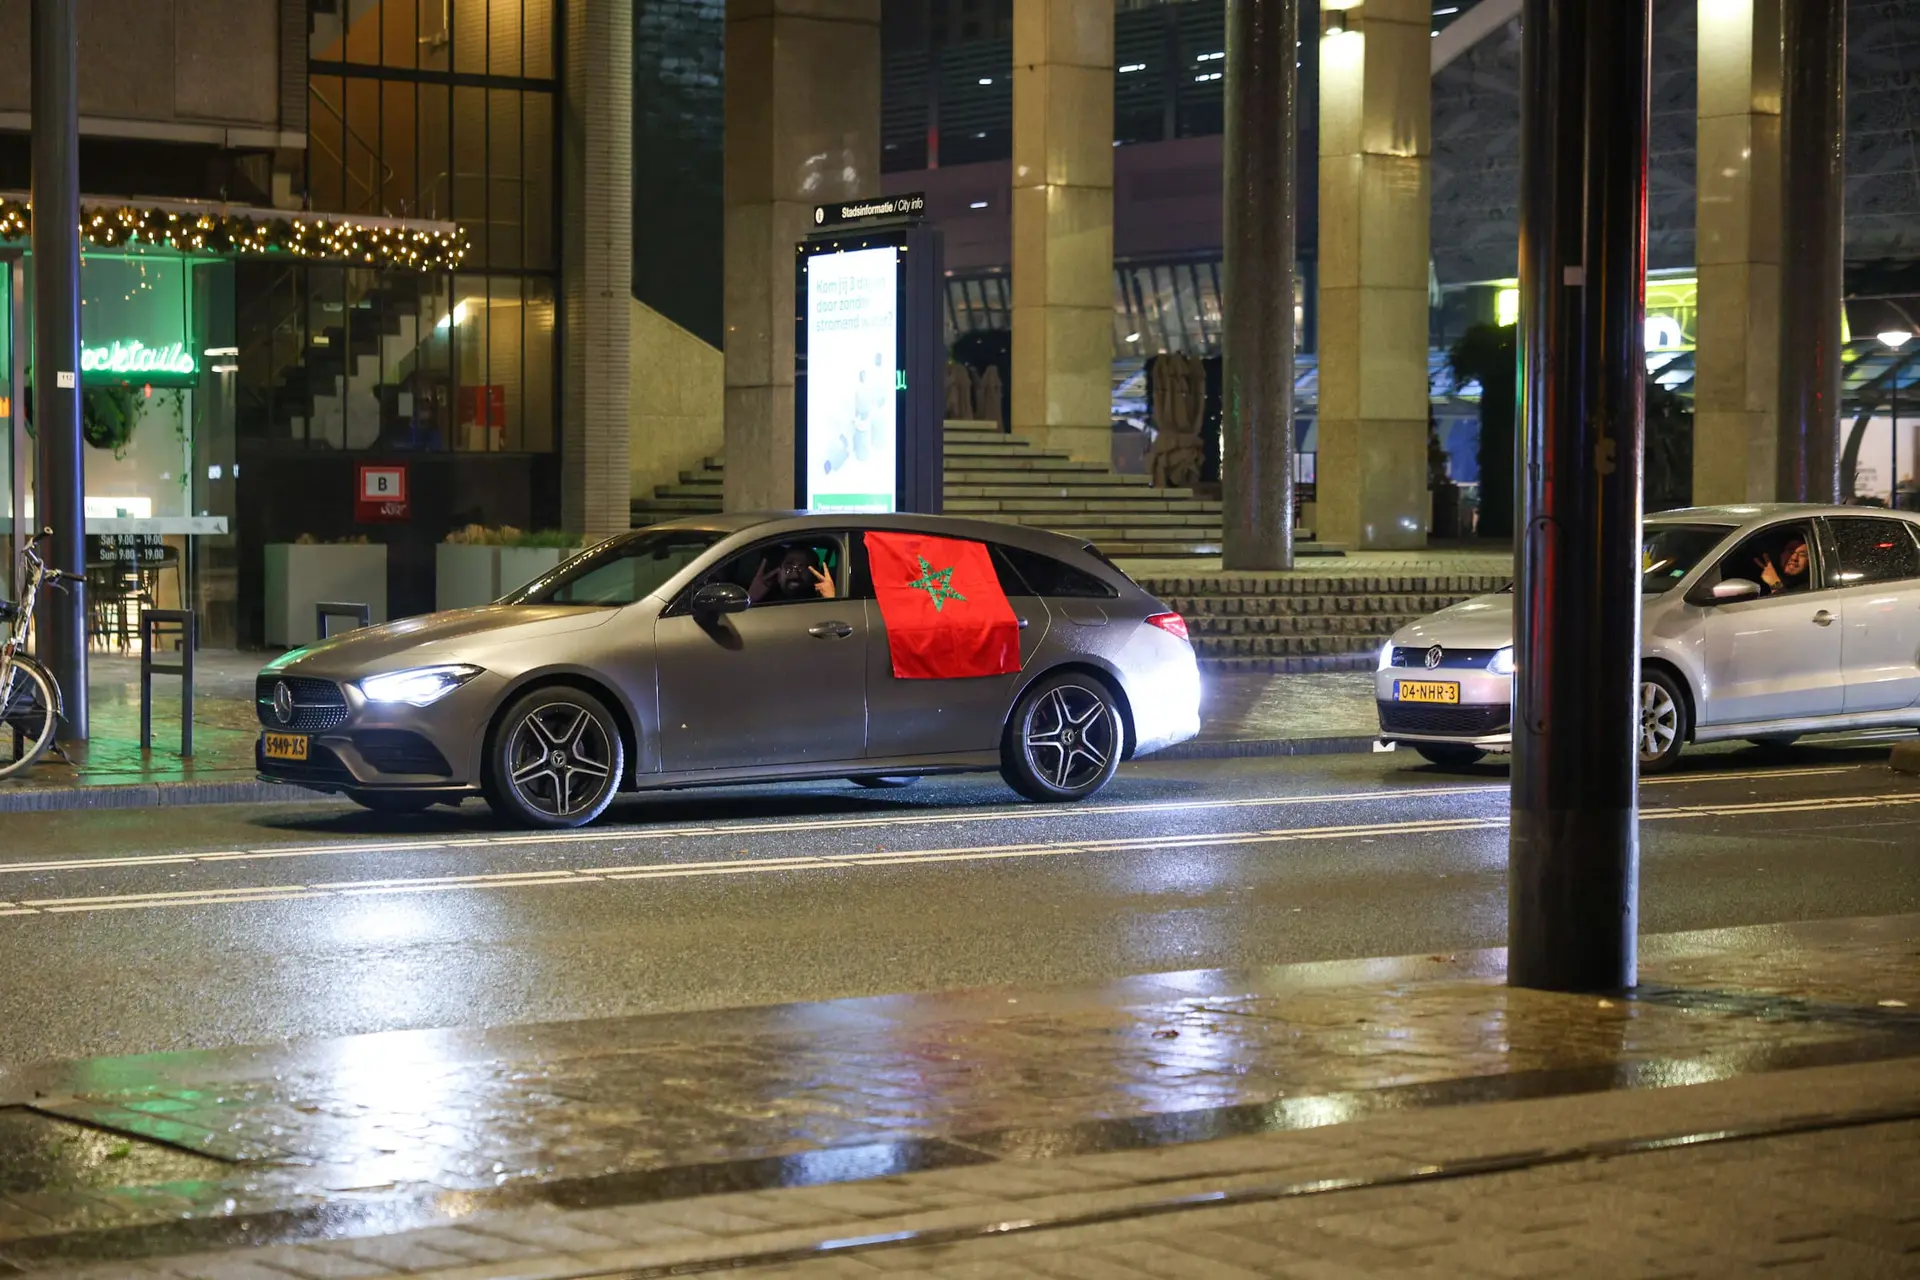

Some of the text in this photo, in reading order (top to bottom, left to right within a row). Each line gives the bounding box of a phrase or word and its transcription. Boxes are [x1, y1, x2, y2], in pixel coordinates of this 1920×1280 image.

[841, 201, 893, 218] Stadsinformatie
[898, 199, 911, 213] City
[911, 197, 924, 209] info
[816, 279, 837, 293] Kom
[838, 276, 848, 295] jij
[849, 275, 855, 291] 3
[816, 298, 837, 313] door
[816, 314, 860, 332] stromend
[81, 339, 195, 373] ocktails
[378, 477, 387, 492] B
[118, 535, 134, 546] 9.00
[144, 535, 163, 546] 19.00
[144, 549, 164, 560] 19.00
[1401, 683, 1456, 700] 04-NHR-3
